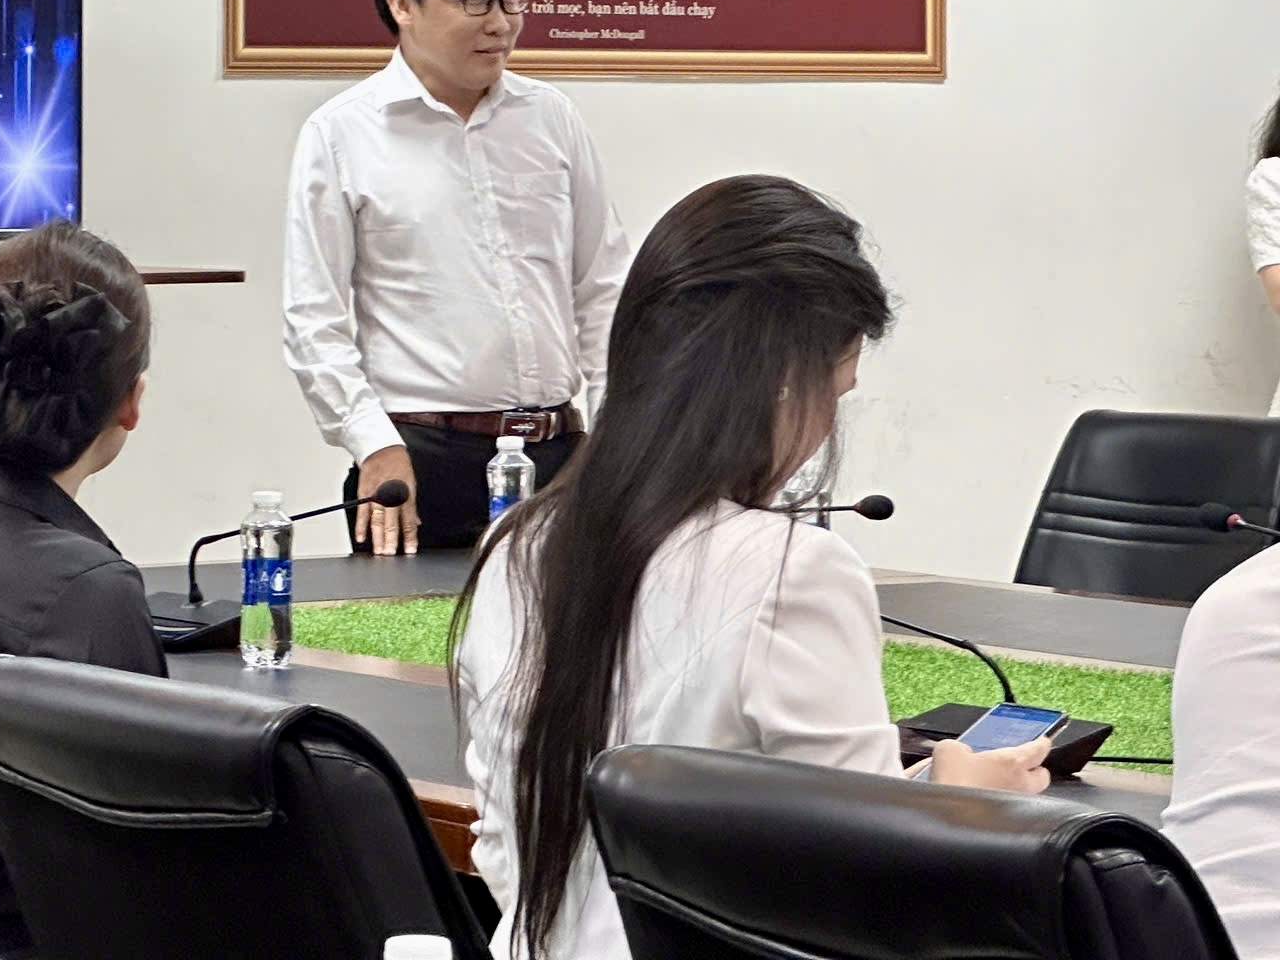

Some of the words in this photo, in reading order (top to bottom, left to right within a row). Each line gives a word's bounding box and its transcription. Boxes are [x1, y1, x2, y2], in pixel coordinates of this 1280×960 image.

[557, 3, 585, 17] mọc,
[588, 1, 611, 17] bạn
[614, 2, 637, 15] nên
[687, 2, 716, 19] chạy
